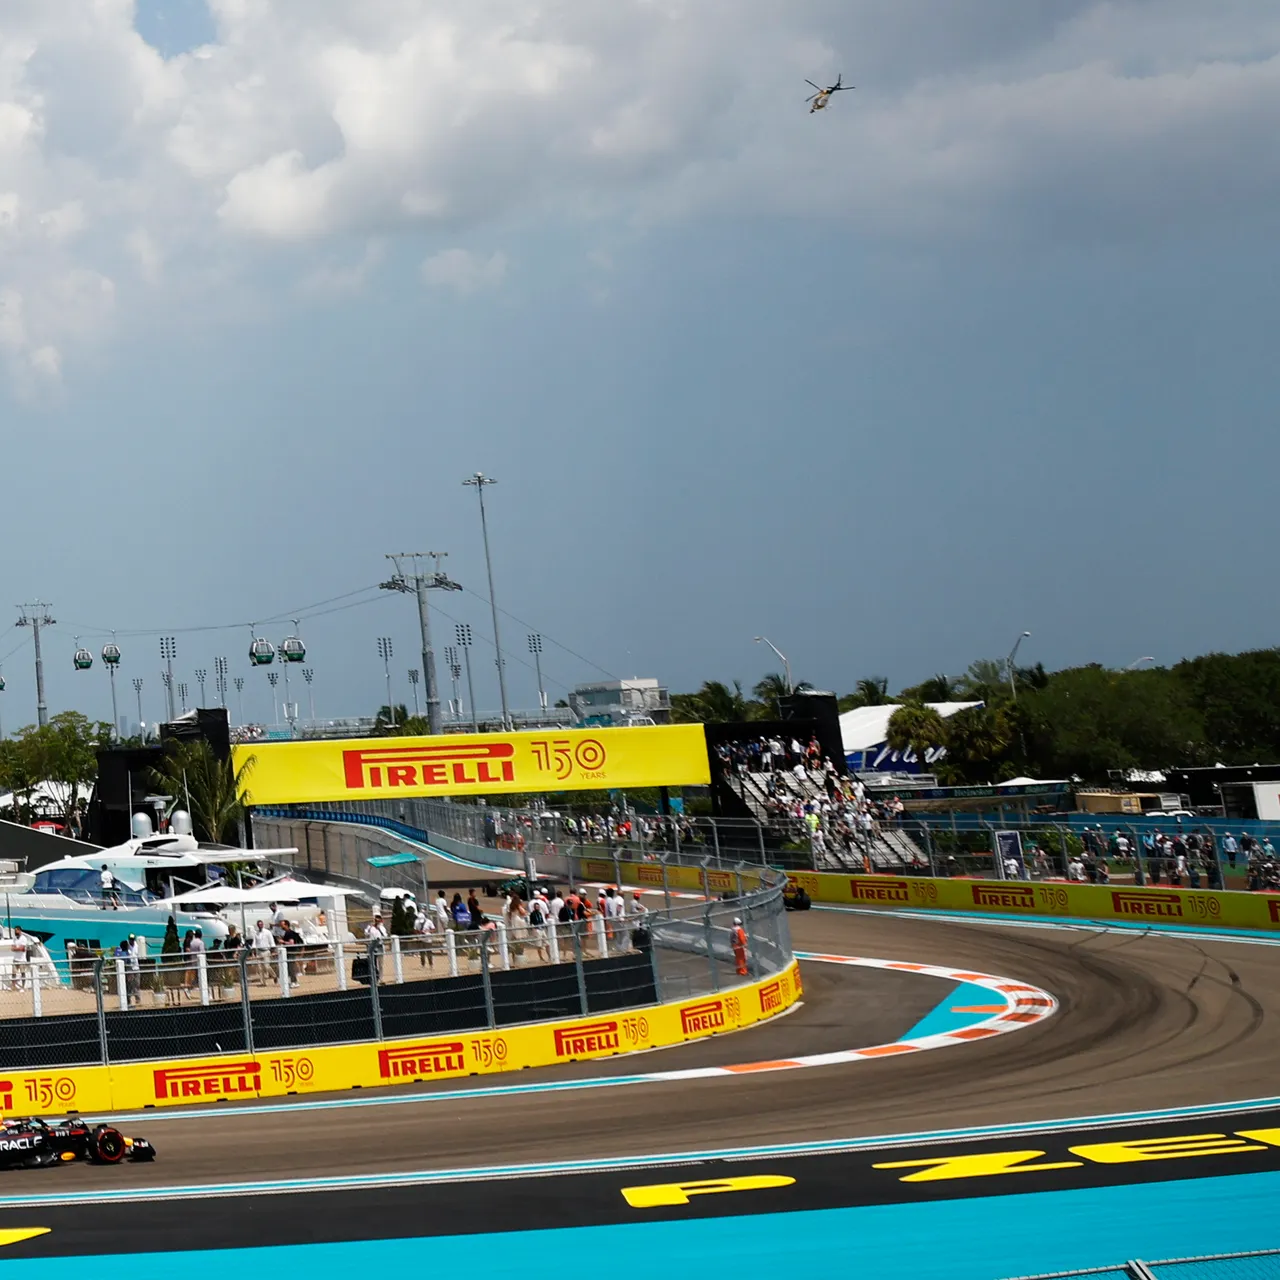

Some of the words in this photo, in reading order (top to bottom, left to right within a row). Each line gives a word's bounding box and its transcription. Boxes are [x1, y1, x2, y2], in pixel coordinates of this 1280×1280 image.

[343, 743, 515, 789] PIRELLI
[530, 739, 606, 780] 150
[580, 771, 607, 780] YEARS
[850, 880, 909, 901] PIRELLI
[912, 882, 938, 903] 150
[972, 885, 1036, 908] PIRELLI
[1040, 887, 1069, 910] 150
[1111, 891, 1183, 917] PIRELLI
[1187, 895, 1221, 918] 150
[758, 981, 782, 1013] PIRELLI
[680, 1000, 725, 1034] PIRELLI
[553, 1021, 620, 1057] PIRELLI
[622, 1016, 649, 1046] 150
[377, 1042, 465, 1078] PIRELLI
[472, 1037, 508, 1068] 150
[24, 1077, 77, 1108] 150
[153, 1061, 263, 1099] PIRELLI
[270, 1057, 315, 1089] 150
[620, 1175, 797, 1209] P
[871, 1127, 1280, 1183] ZE
